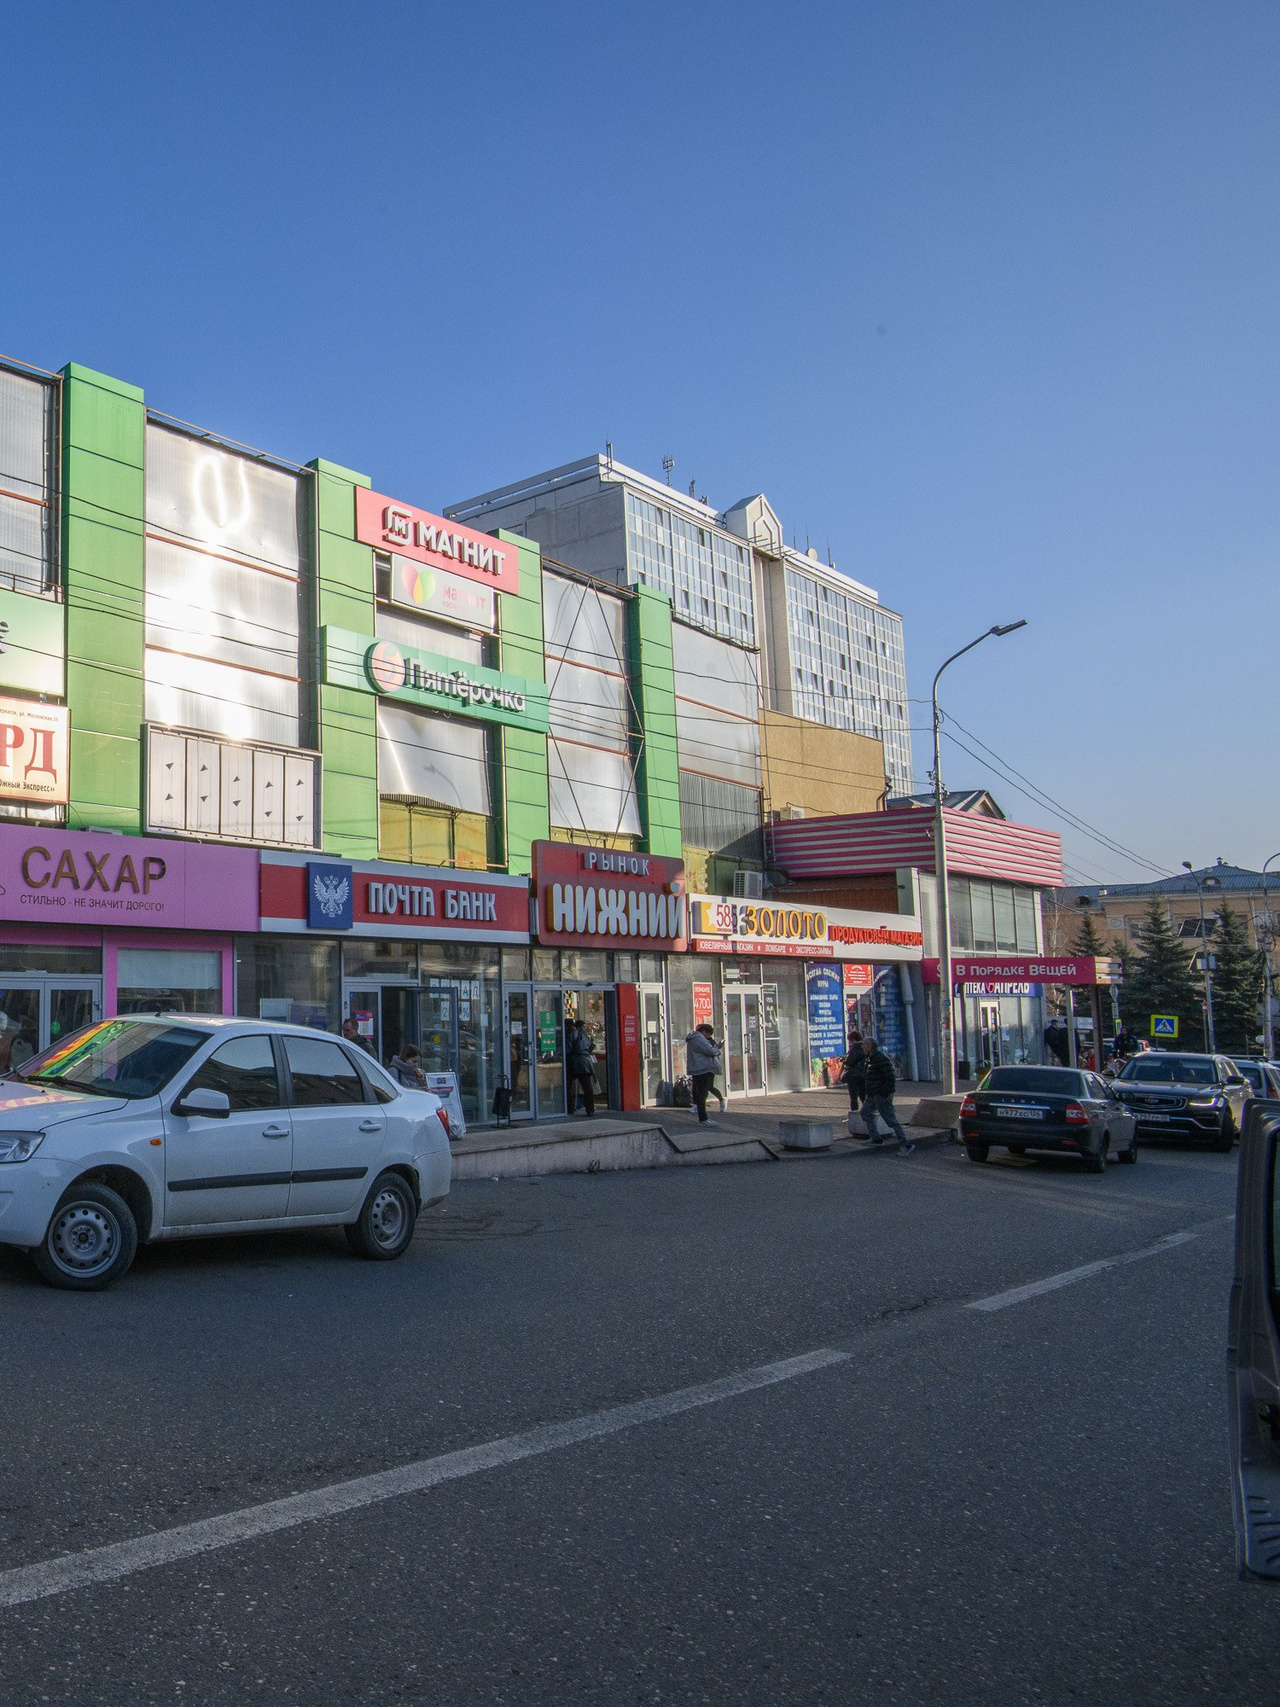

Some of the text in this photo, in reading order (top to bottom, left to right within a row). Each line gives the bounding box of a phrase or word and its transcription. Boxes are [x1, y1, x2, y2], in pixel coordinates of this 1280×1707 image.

[418, 519, 506, 577] МАГНИТ
[404, 657, 526, 712] Пятёрочка
[21, 844, 167, 895] САХАР
[583, 852, 650, 877] РЫНОК
[20, 894, 67, 907] СТИЛЬНО
[73, 897, 87, 908] НЕ
[89, 898, 125, 911] ЗНАЧИТ
[126, 900, 166, 913] ДОРОГО!
[368, 881, 497, 922] ПОЧТА БАНК
[548, 881, 685, 939] НИЖНИЙ
[890, 930, 923, 947] МАГАЗИН
[955, 964, 966, 976] В
[964, 982, 986, 994] ПТЕКА
